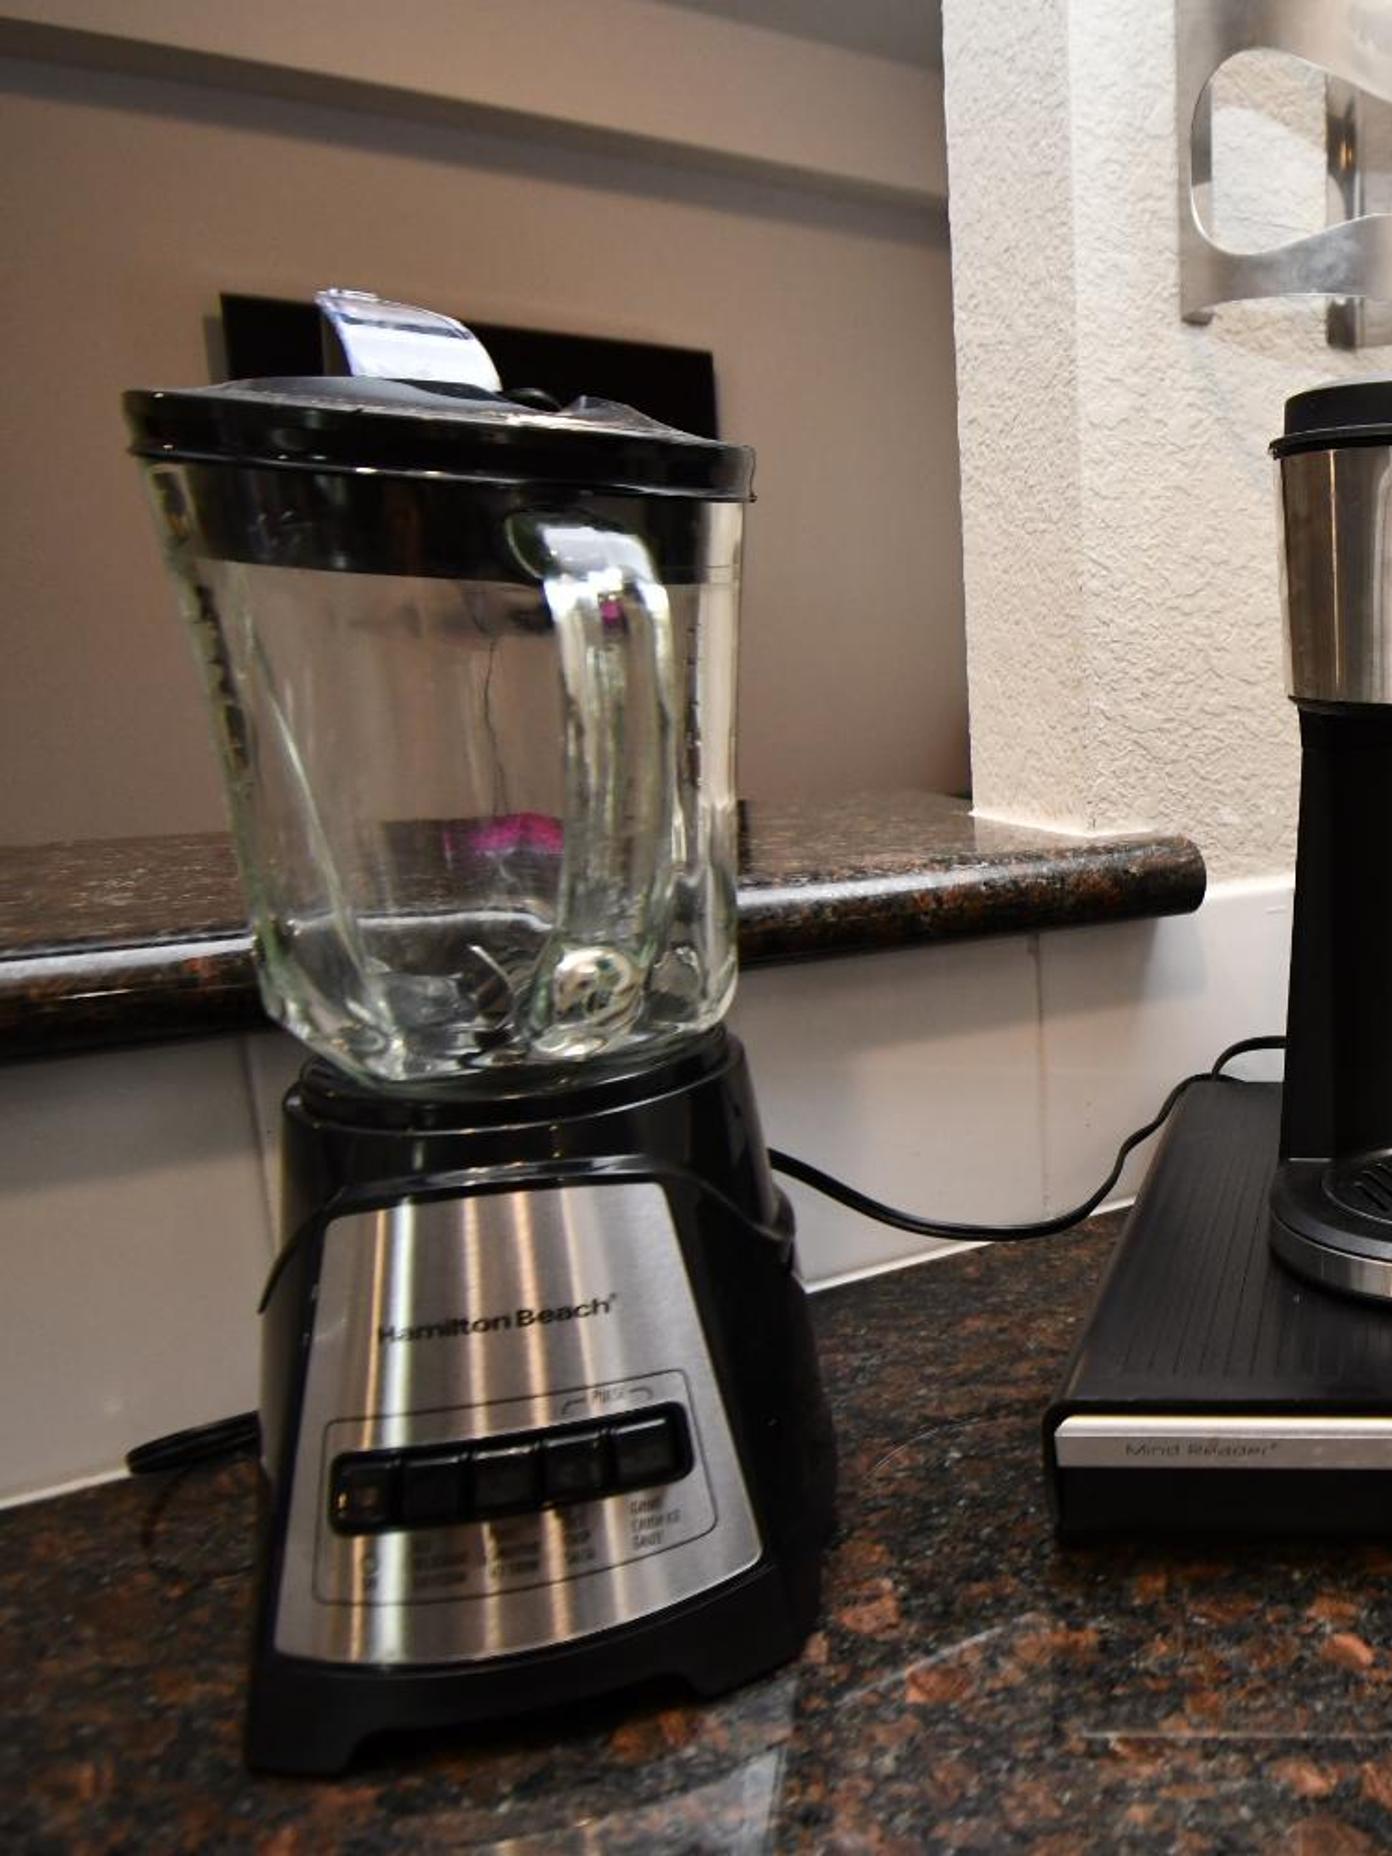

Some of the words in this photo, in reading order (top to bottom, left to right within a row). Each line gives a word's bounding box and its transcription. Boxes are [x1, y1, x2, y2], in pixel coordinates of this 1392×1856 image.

[378, 1312, 513, 1345] Hamilton
[514, 1298, 611, 1328] Beach
[1125, 1443, 1180, 1456] Mind
